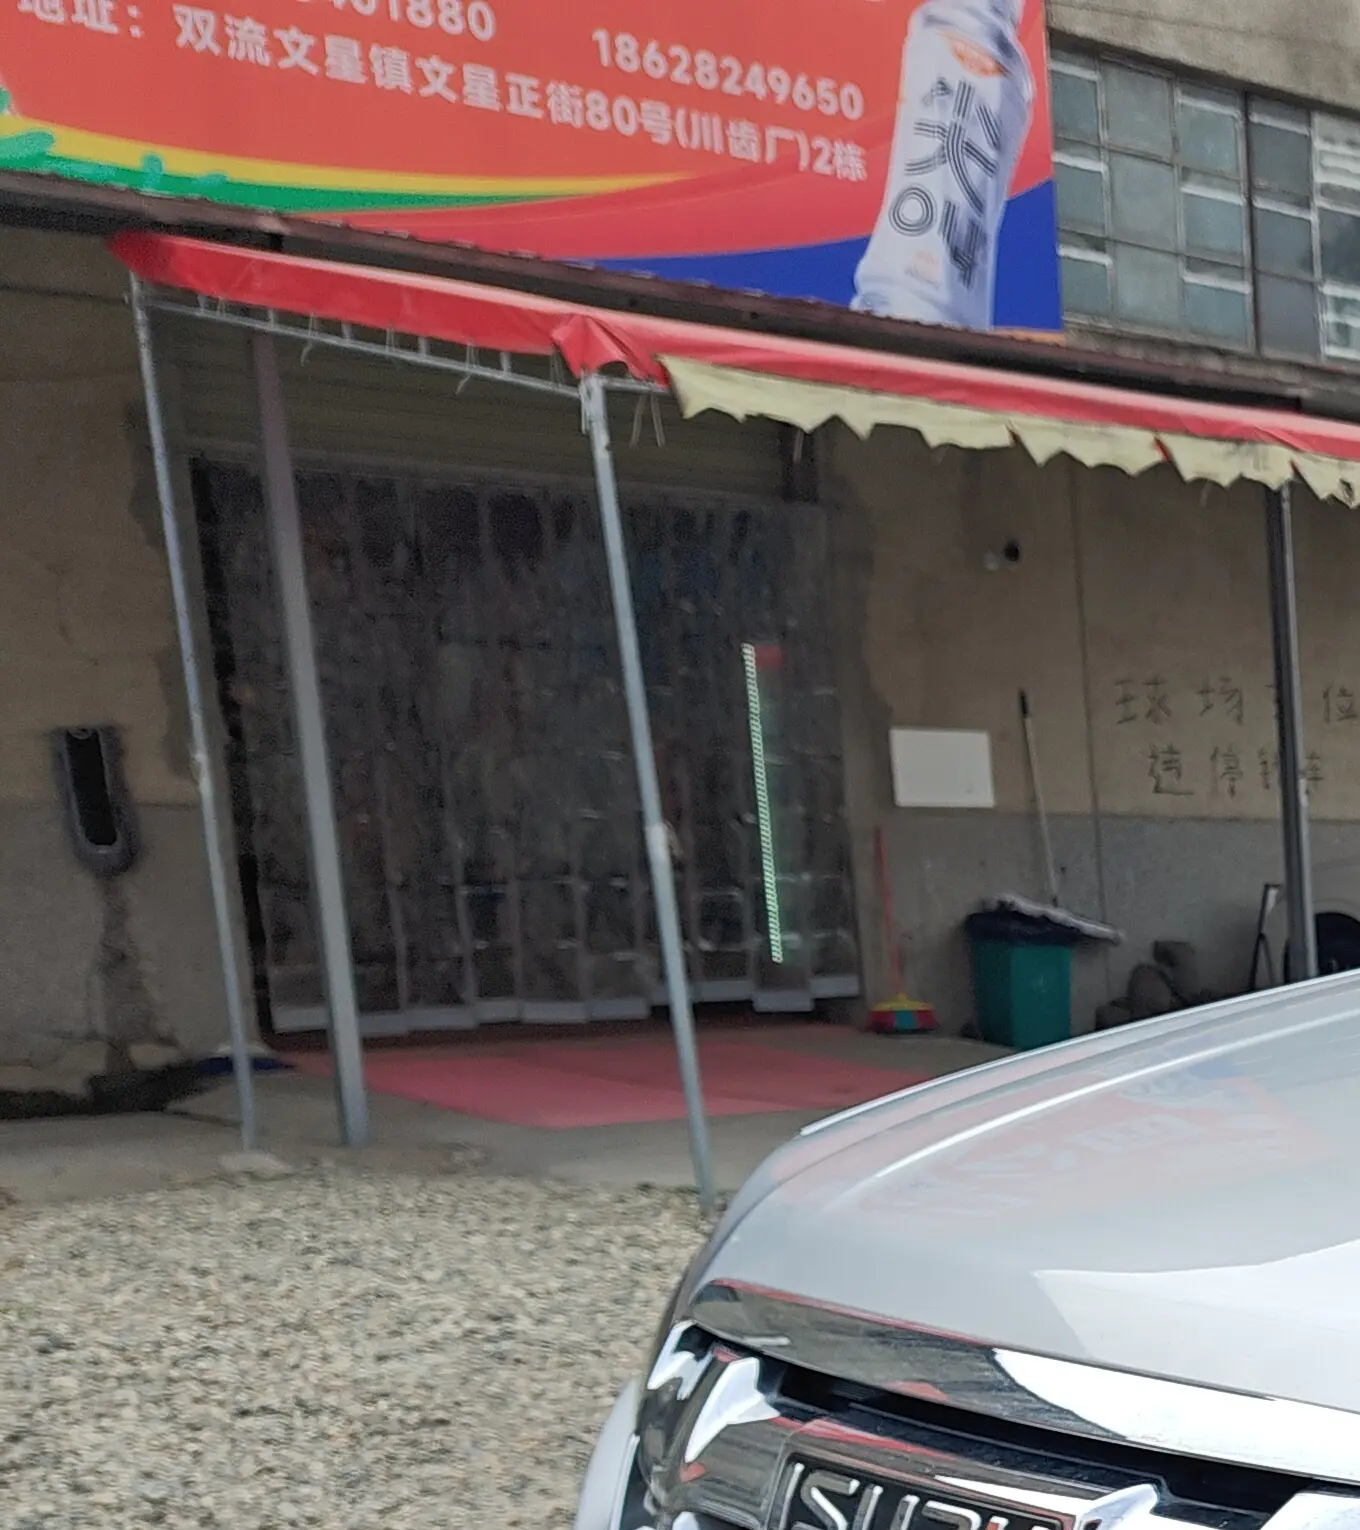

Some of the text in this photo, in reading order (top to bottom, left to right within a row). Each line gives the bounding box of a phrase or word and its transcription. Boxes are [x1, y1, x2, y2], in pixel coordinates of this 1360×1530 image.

[591, 27, 865, 121] 18628249650
[1112, 673, 1360, 727] 球场位
